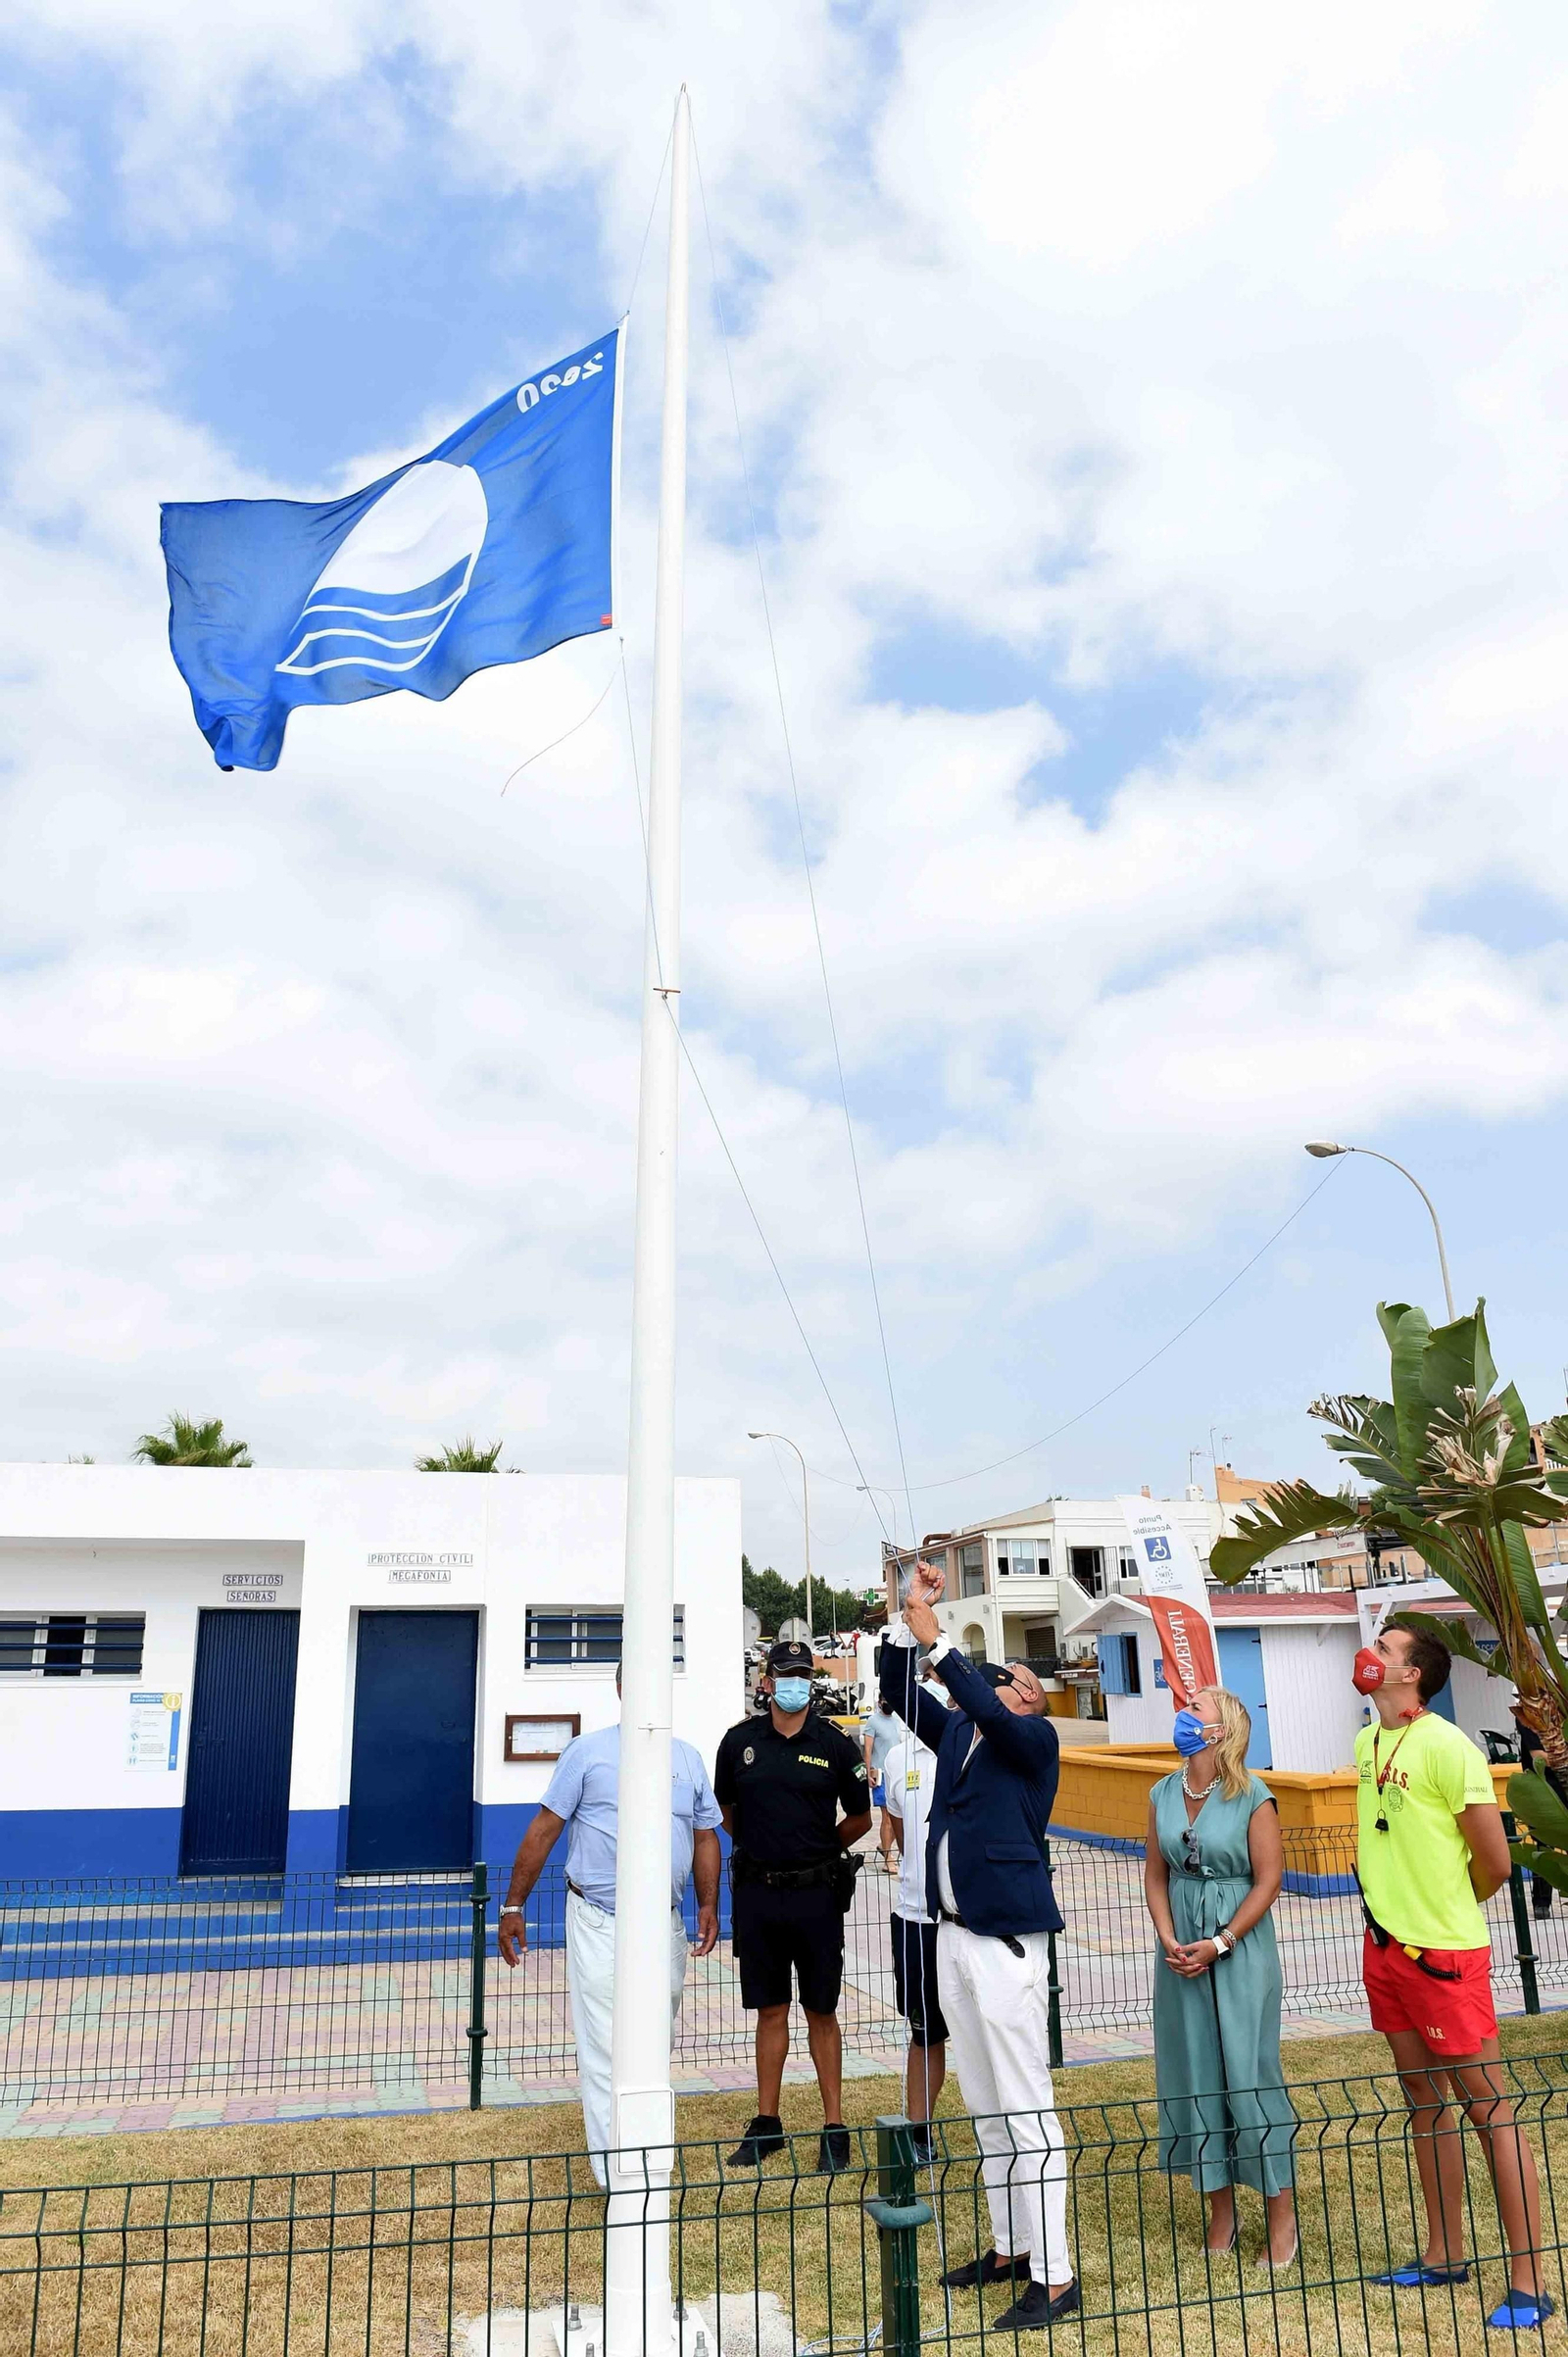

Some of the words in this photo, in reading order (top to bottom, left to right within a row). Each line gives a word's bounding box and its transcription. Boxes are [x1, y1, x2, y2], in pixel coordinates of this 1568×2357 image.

[439, 1553, 470, 1563] CIVIL
[224, 1575, 280, 1585] SERVICIOS
[798, 1754, 829, 1768] POLICIA
